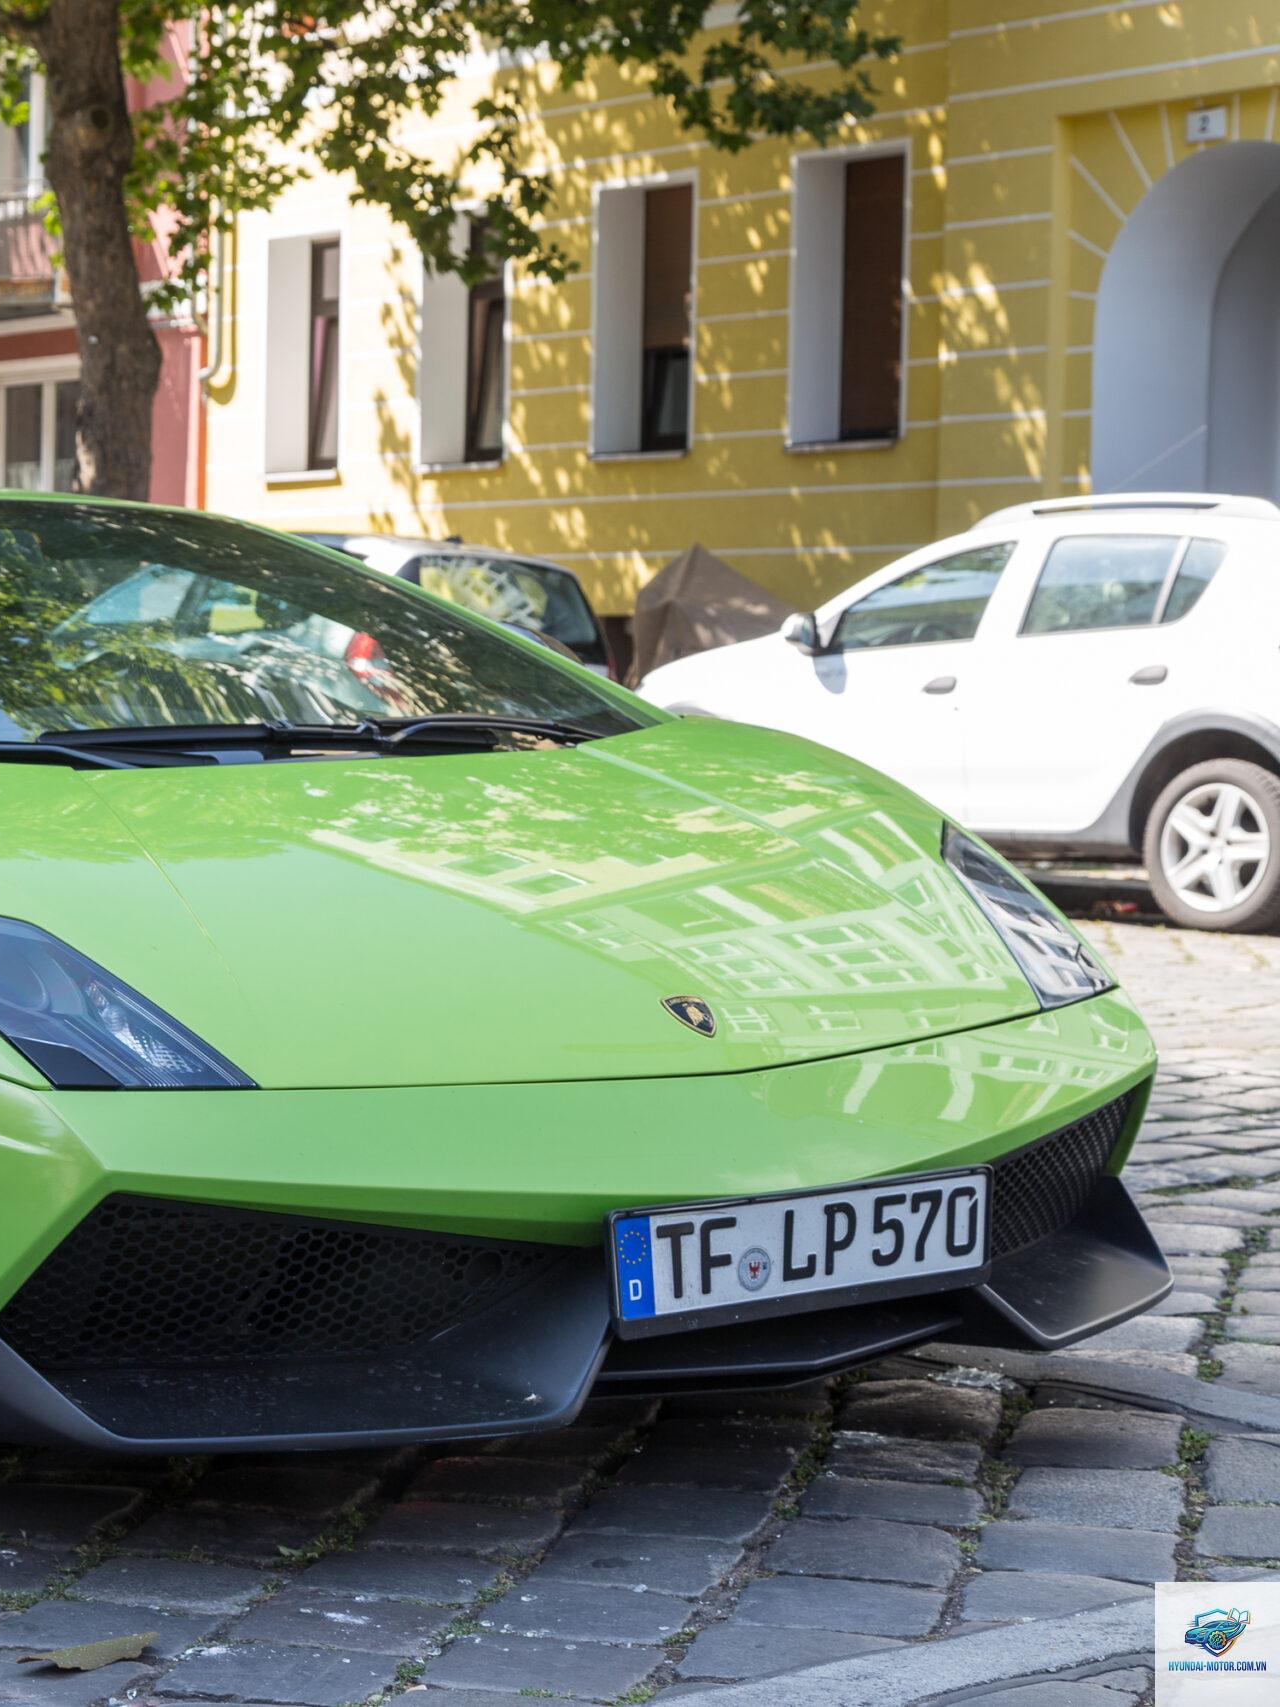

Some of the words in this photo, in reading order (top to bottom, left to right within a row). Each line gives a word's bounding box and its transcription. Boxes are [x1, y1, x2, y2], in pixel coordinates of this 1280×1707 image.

[1198, 114, 1210, 134] 2
[655, 1216, 737, 1299] TF
[782, 1201, 857, 1282] LP
[871, 1186, 978, 1267] 570
[628, 1279, 642, 1301] D
